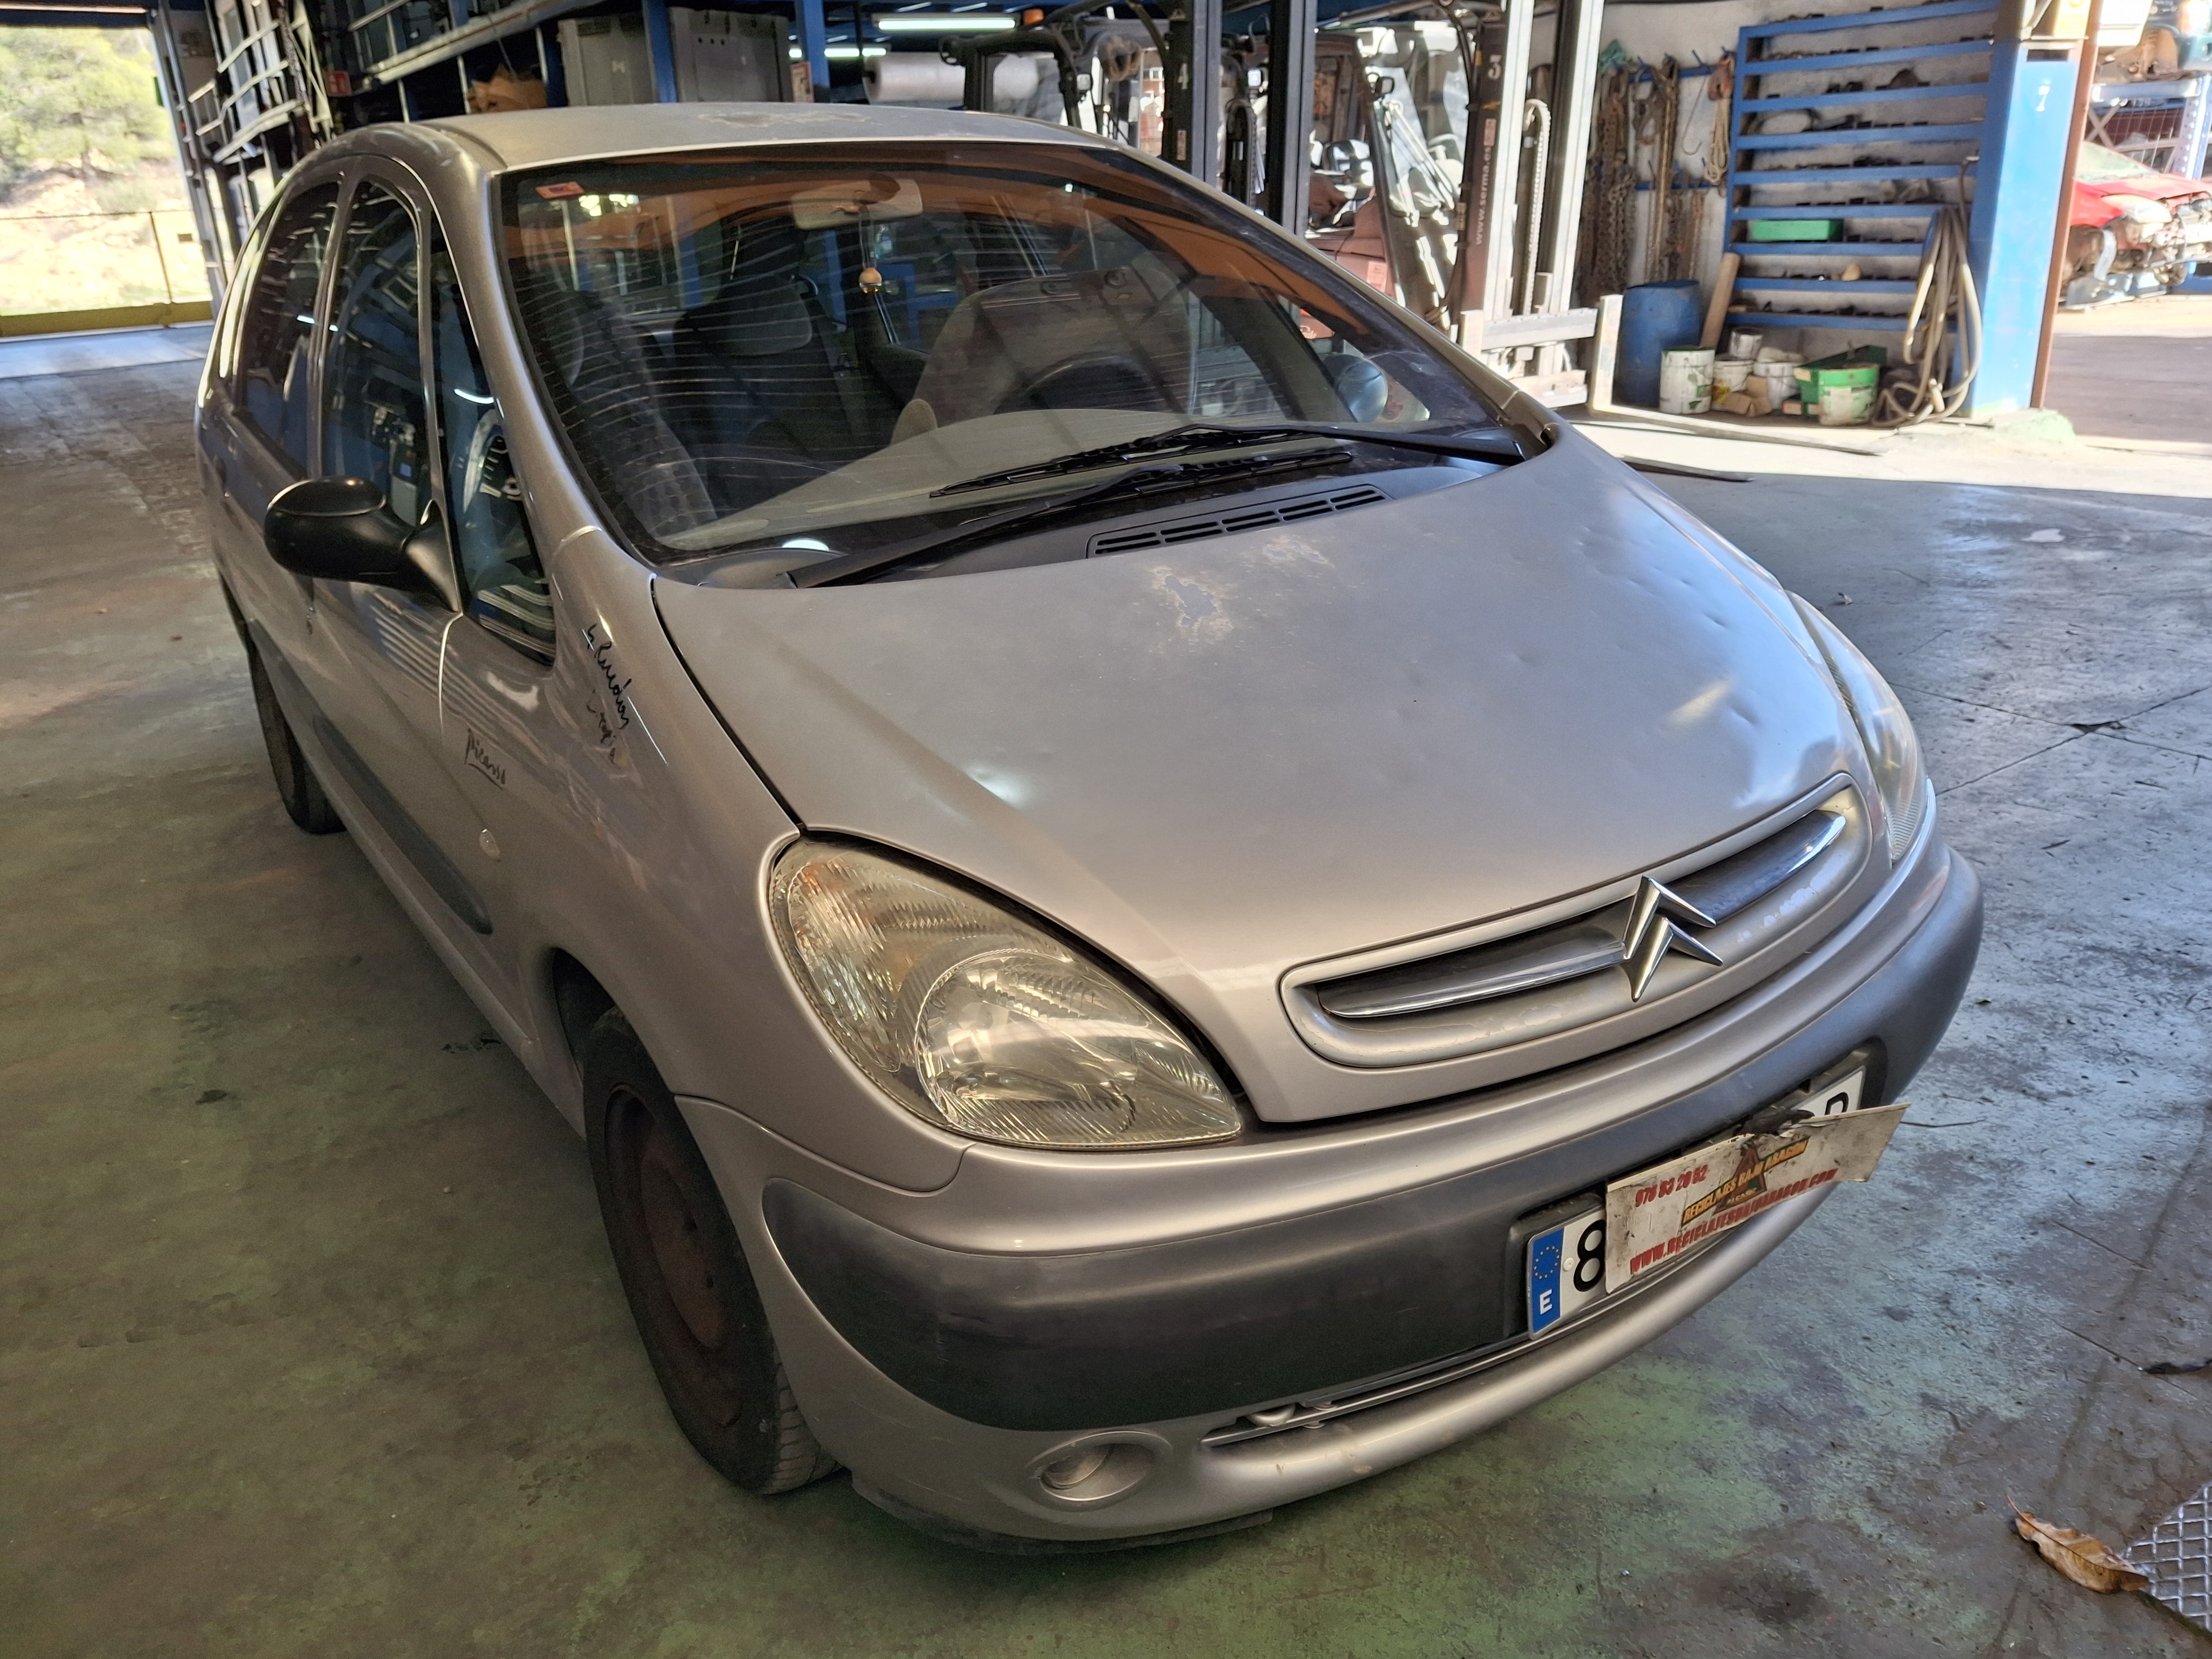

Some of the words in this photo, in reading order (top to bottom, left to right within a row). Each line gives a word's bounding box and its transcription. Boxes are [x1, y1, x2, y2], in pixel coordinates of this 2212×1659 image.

[1476, 146, 1491, 246] www.serma.es
[1675, 1171, 1692, 1192] 20
[1683, 1179, 1738, 1225] RECICLAJES
[1540, 1289, 1553, 1315] E
